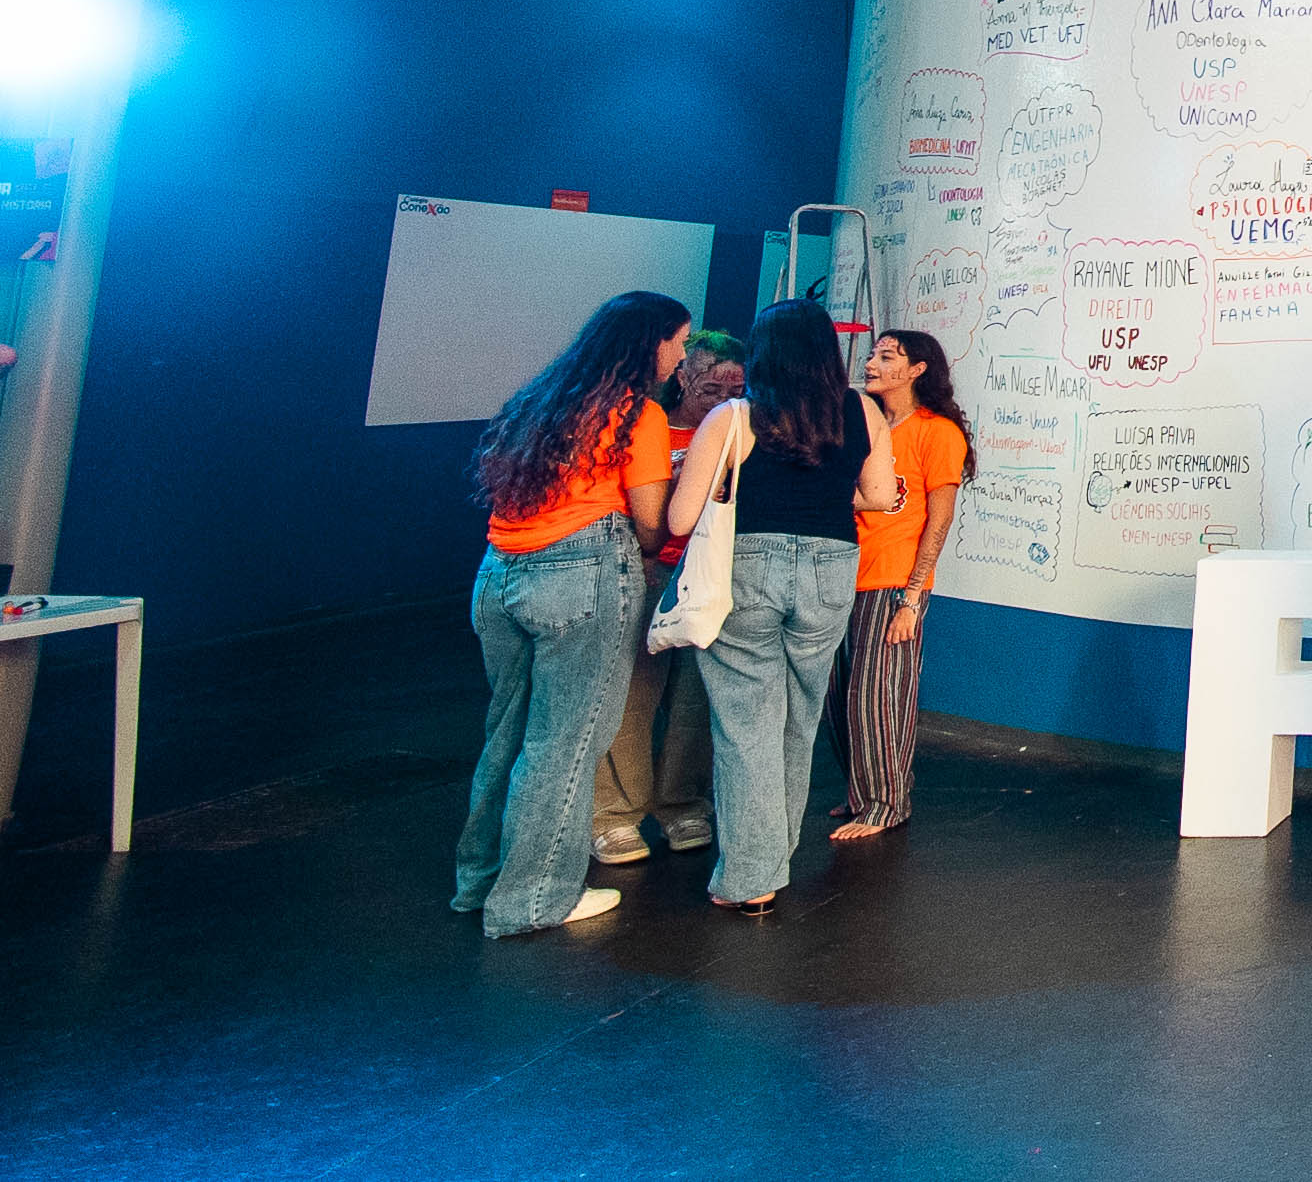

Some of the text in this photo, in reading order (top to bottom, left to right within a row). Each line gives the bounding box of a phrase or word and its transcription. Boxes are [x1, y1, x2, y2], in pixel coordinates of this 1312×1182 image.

[987, 31, 1014, 52] MED
[1020, 25, 1049, 44] VET
[1193, 57, 1237, 79] USP
[1180, 80, 1248, 103] UNESP
[1028, 103, 1073, 126] UTFPR
[1011, 123, 1094, 155] ENGENHARIA
[1231, 218, 1294, 244] UEMG
[1073, 260, 1135, 288] RAYANE
[1089, 298, 1154, 320] DIREITO
[1219, 301, 1299, 322] FAMEMA
[1102, 327, 1140, 350] USP
[1088, 353, 1169, 372] UFU UNESP
[984, 355, 1092, 402] ANA NILSE MACARI
[1160, 425, 1196, 446] PAIVA
[1093, 450, 1250, 474] RELAÇÕES INTERNACIONAIS
[1111, 499, 1211, 521] CIÊNCIAS SOCIAIS
